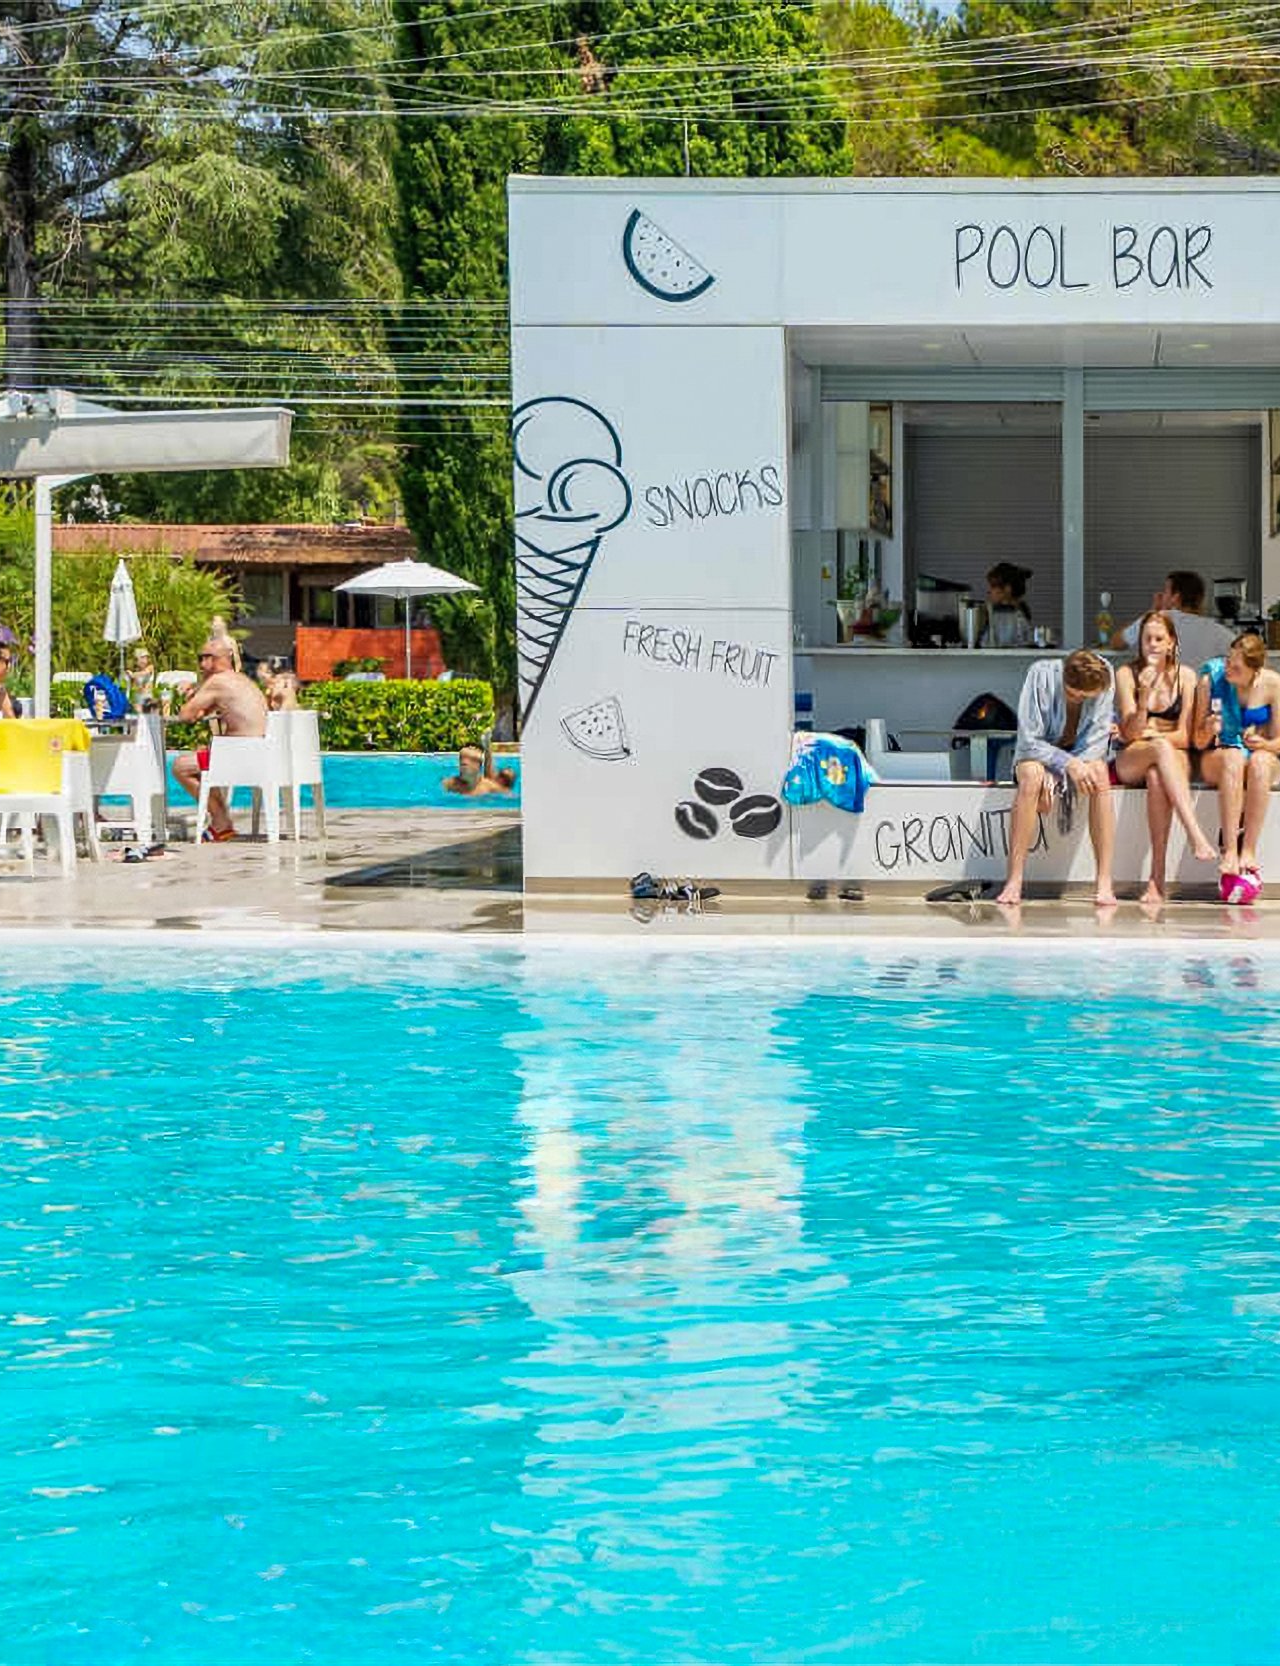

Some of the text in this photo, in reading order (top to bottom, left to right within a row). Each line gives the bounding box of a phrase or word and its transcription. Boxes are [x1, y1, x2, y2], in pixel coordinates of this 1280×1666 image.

[955, 224, 1214, 290] POOL BAR
[645, 466, 782, 526] SNACKS
[623, 620, 779, 687] FRESH FRUIT
